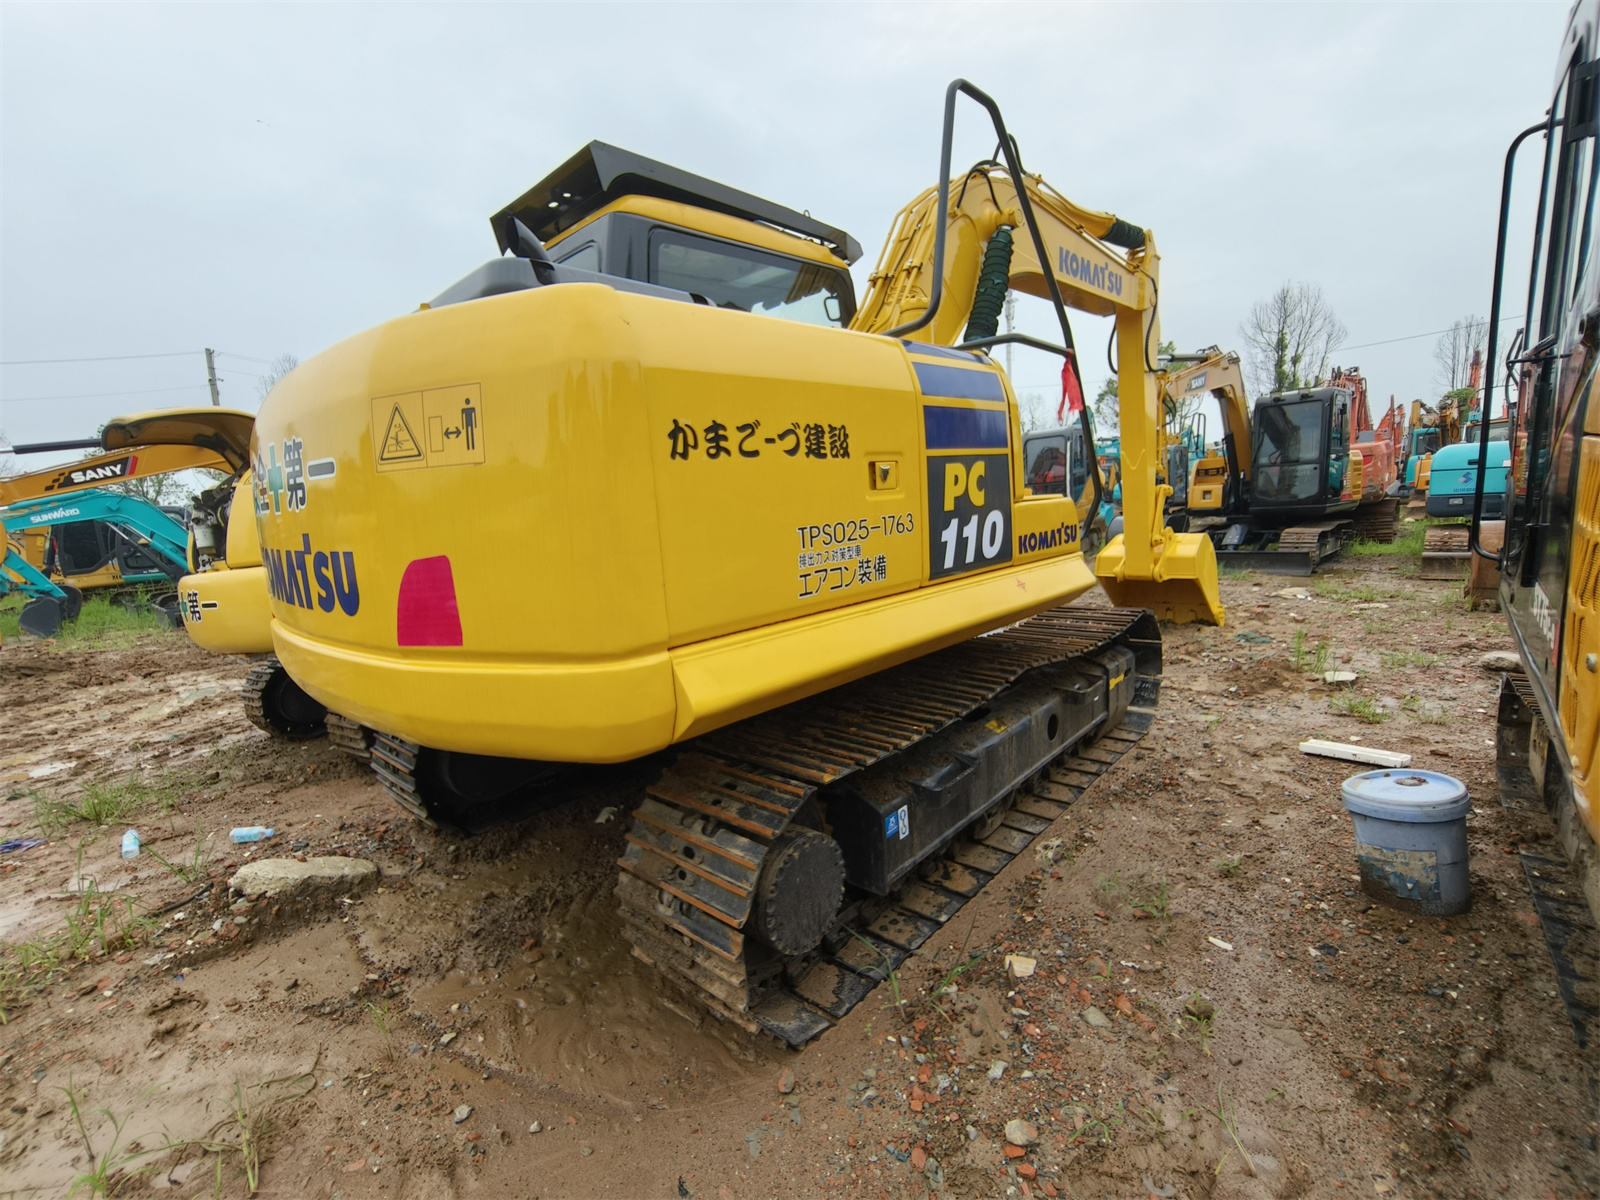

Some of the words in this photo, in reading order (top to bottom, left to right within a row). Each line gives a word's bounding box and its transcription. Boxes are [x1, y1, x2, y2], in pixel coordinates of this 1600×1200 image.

[1058, 246, 1122, 297] KOMATSU
[70, 464, 122, 483] SANY
[943, 460, 986, 512] PC
[30, 507, 80, 523] SUNWARD
[797, 512, 915, 549] TPS025-1763
[941, 509, 1004, 570] 110
[1018, 522, 1078, 555] KOMATSU
[798, 555, 887, 598] エアコン装備
